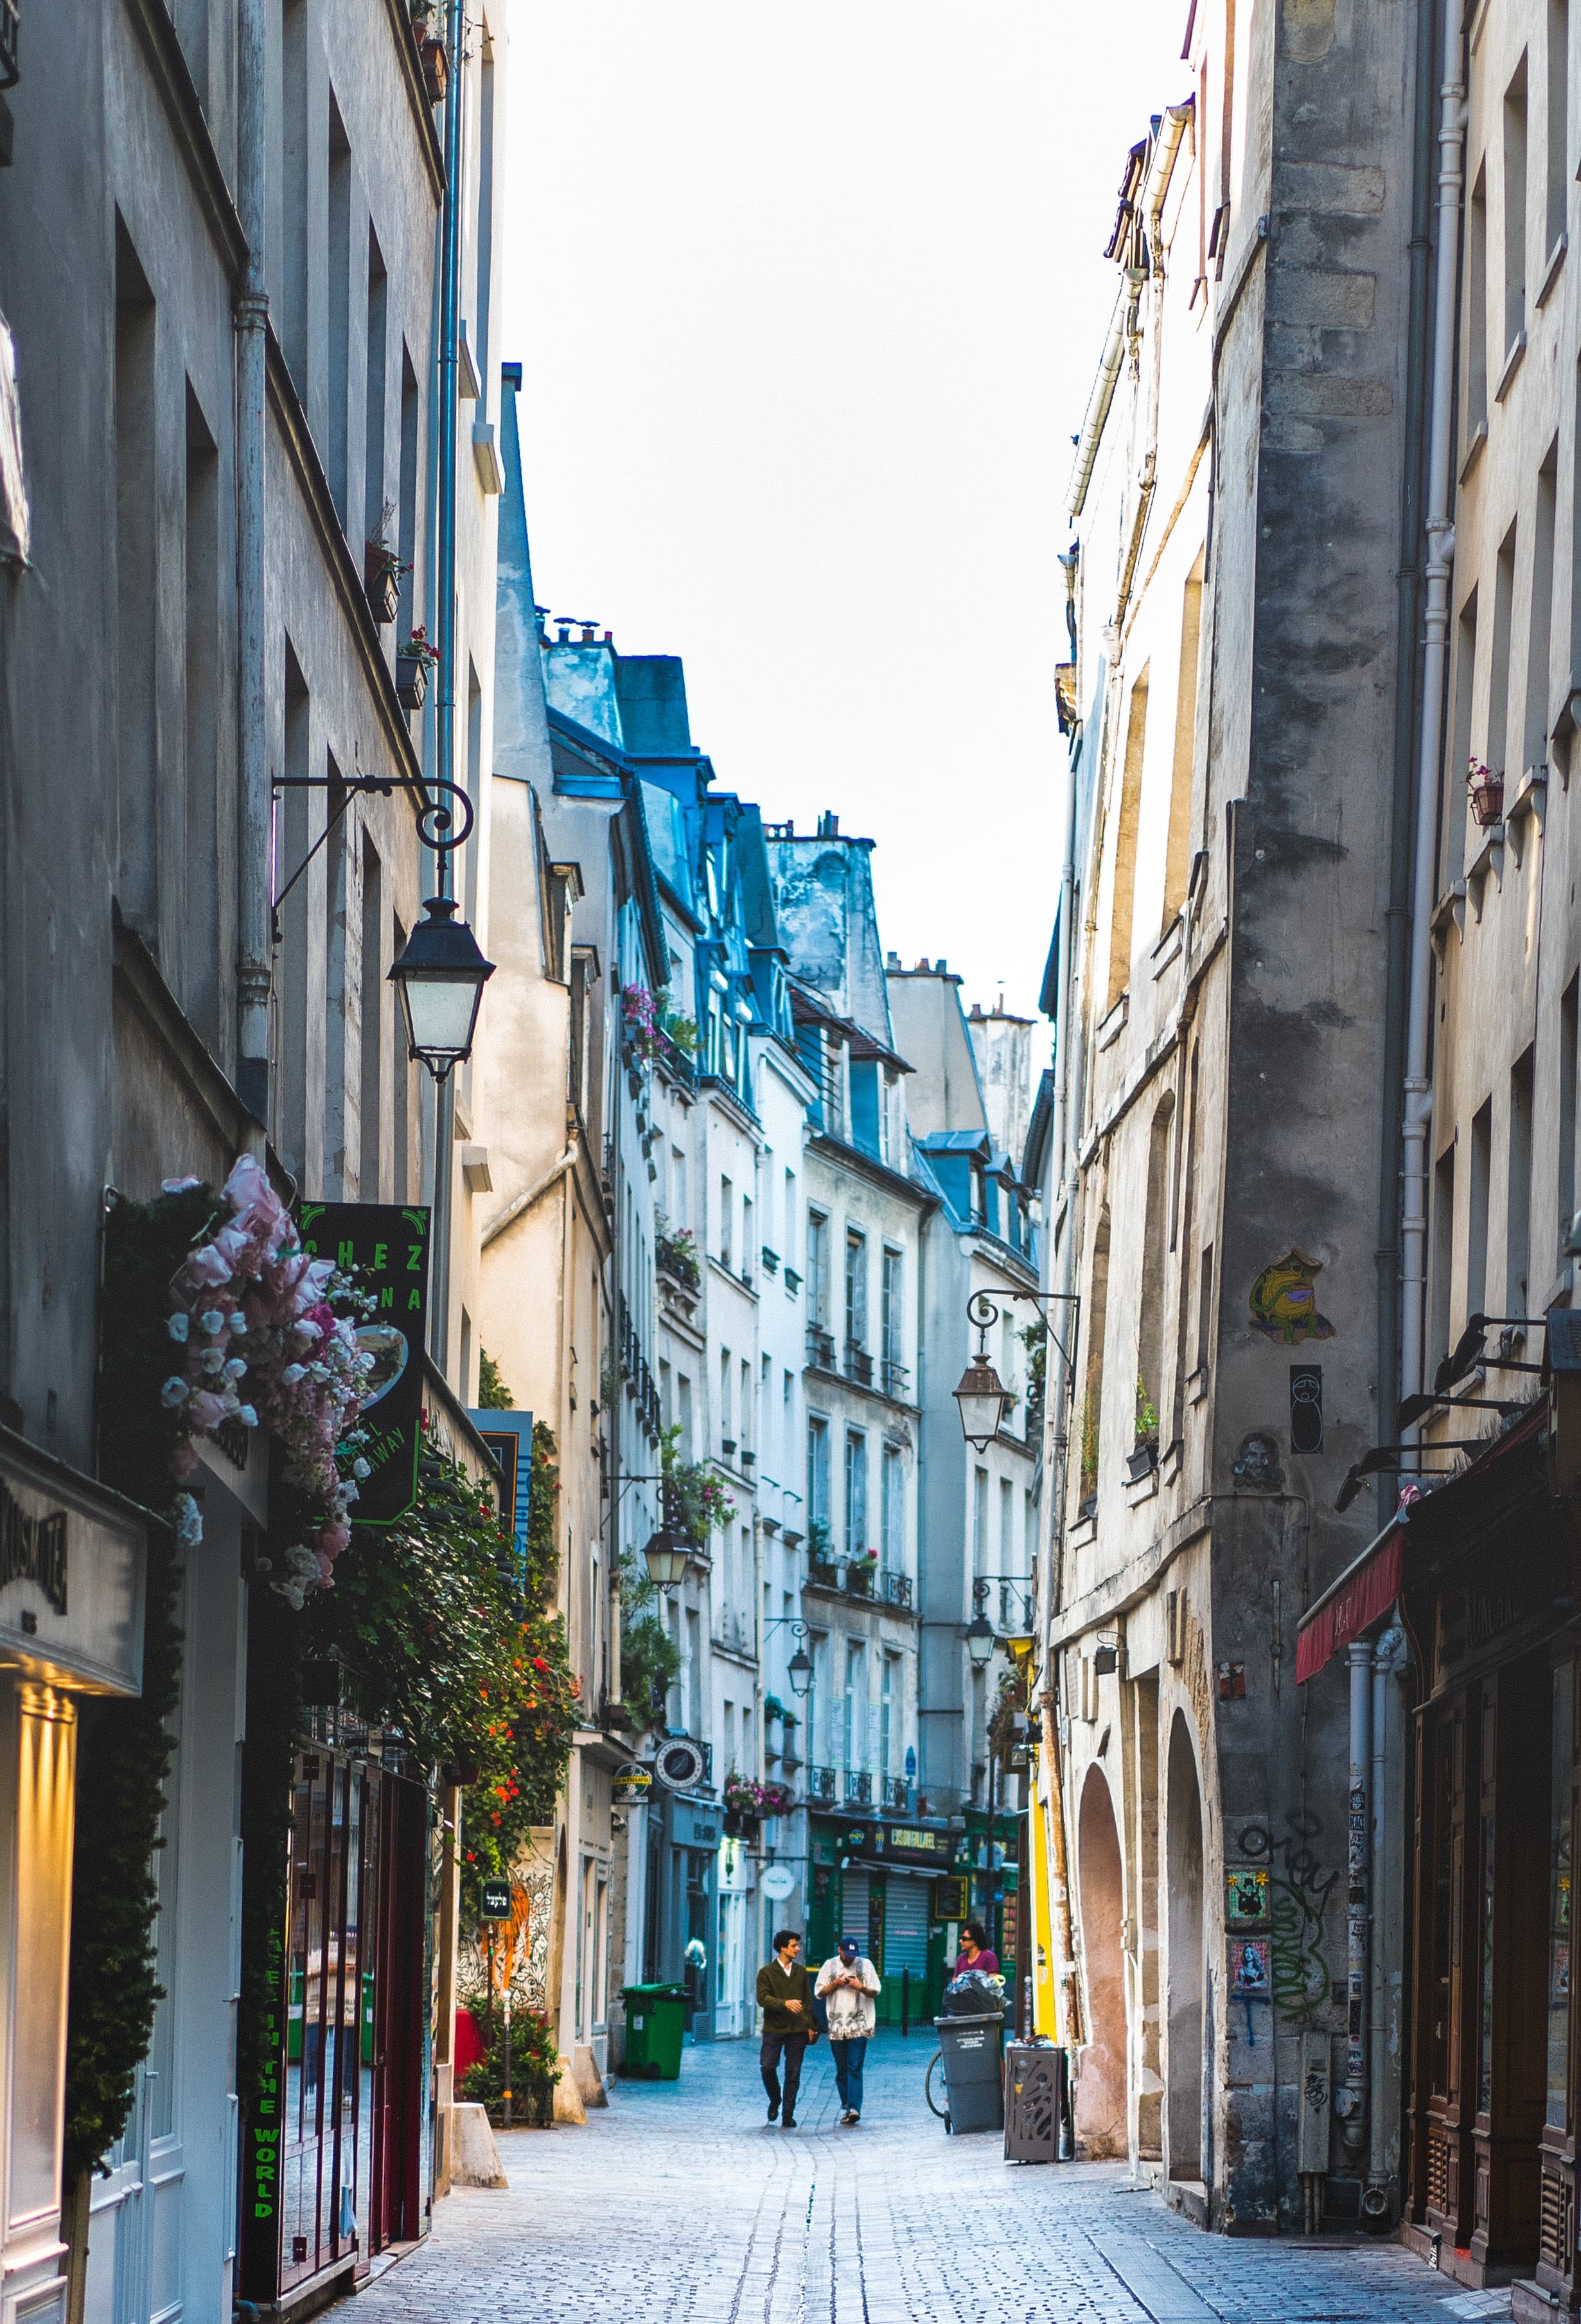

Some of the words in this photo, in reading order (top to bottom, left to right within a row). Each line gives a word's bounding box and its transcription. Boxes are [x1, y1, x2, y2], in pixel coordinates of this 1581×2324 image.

[303, 1240, 422, 1271] CHEZ
[367, 1427, 405, 1473] AWAY
[254, 2128, 280, 2218] WORLD
